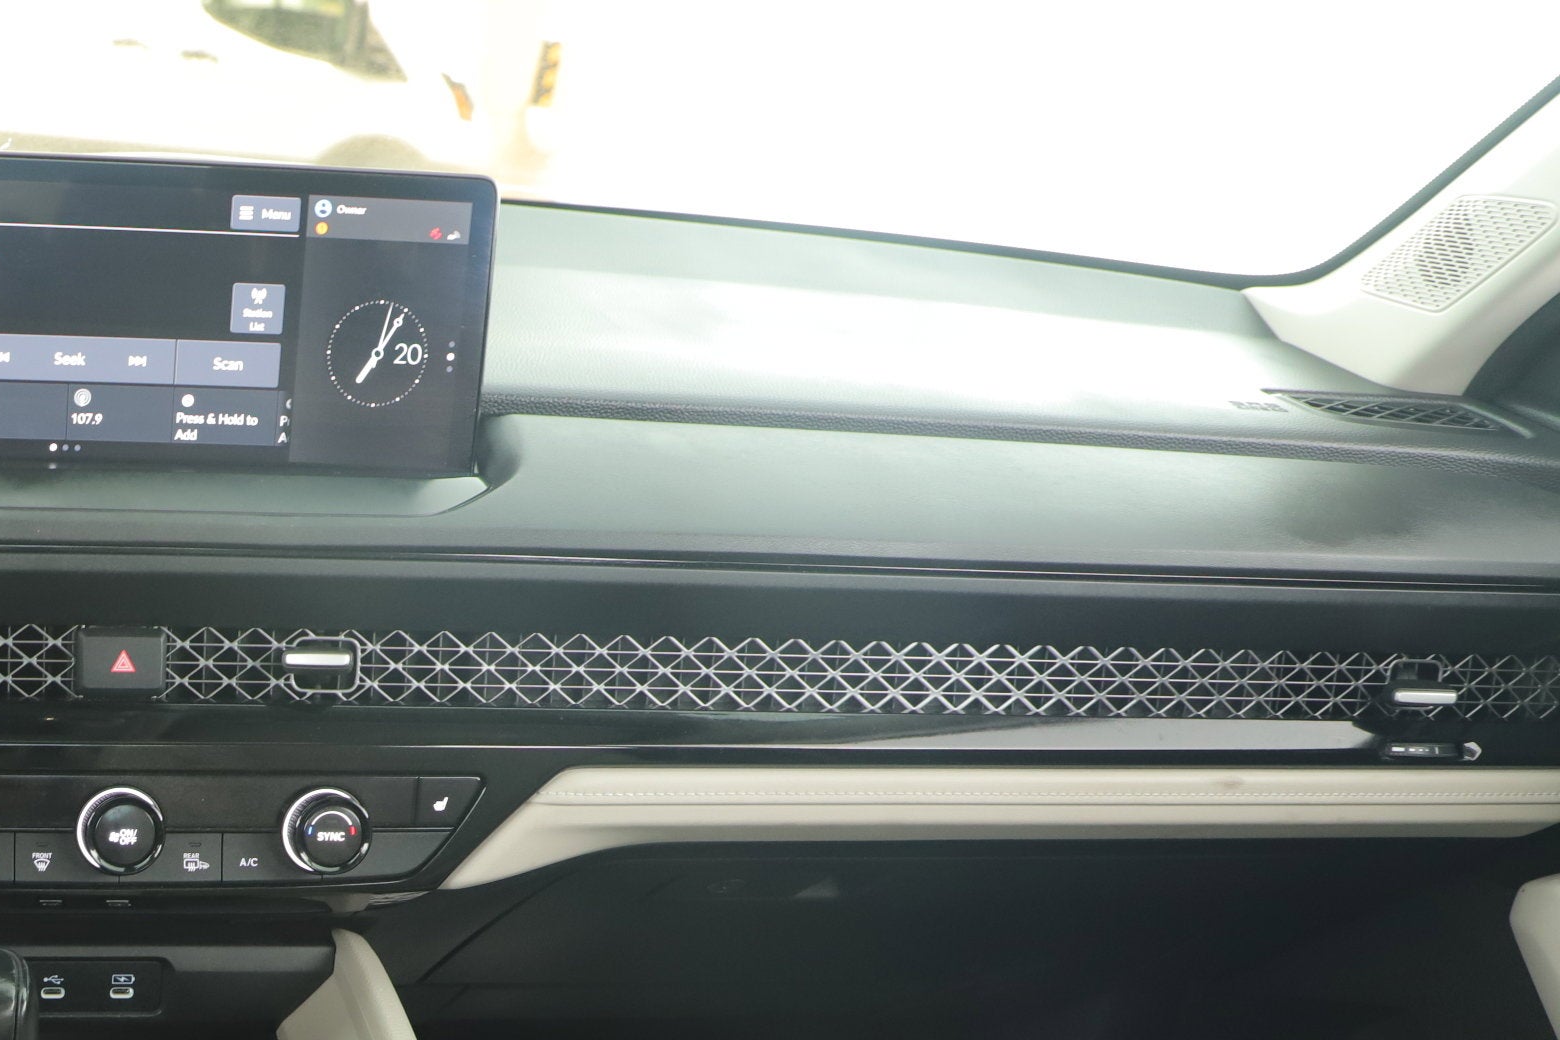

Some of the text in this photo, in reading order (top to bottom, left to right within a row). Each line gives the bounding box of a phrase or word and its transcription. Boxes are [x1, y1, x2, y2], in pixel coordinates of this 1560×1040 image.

[261, 208, 292, 220] Menu
[336, 204, 367, 215] Owner
[242, 307, 273, 318] Station
[53, 351, 87, 366] Seek
[393, 342, 423, 366] 20
[212, 357, 244, 371] Scan
[71, 413, 103, 425] 107.9
[175, 411, 259, 426] Press & Hold to
[174, 428, 198, 441] Add
[119, 837, 138, 846] OFF
[316, 831, 346, 842] SYNC
[239, 857, 258, 867] A/C
